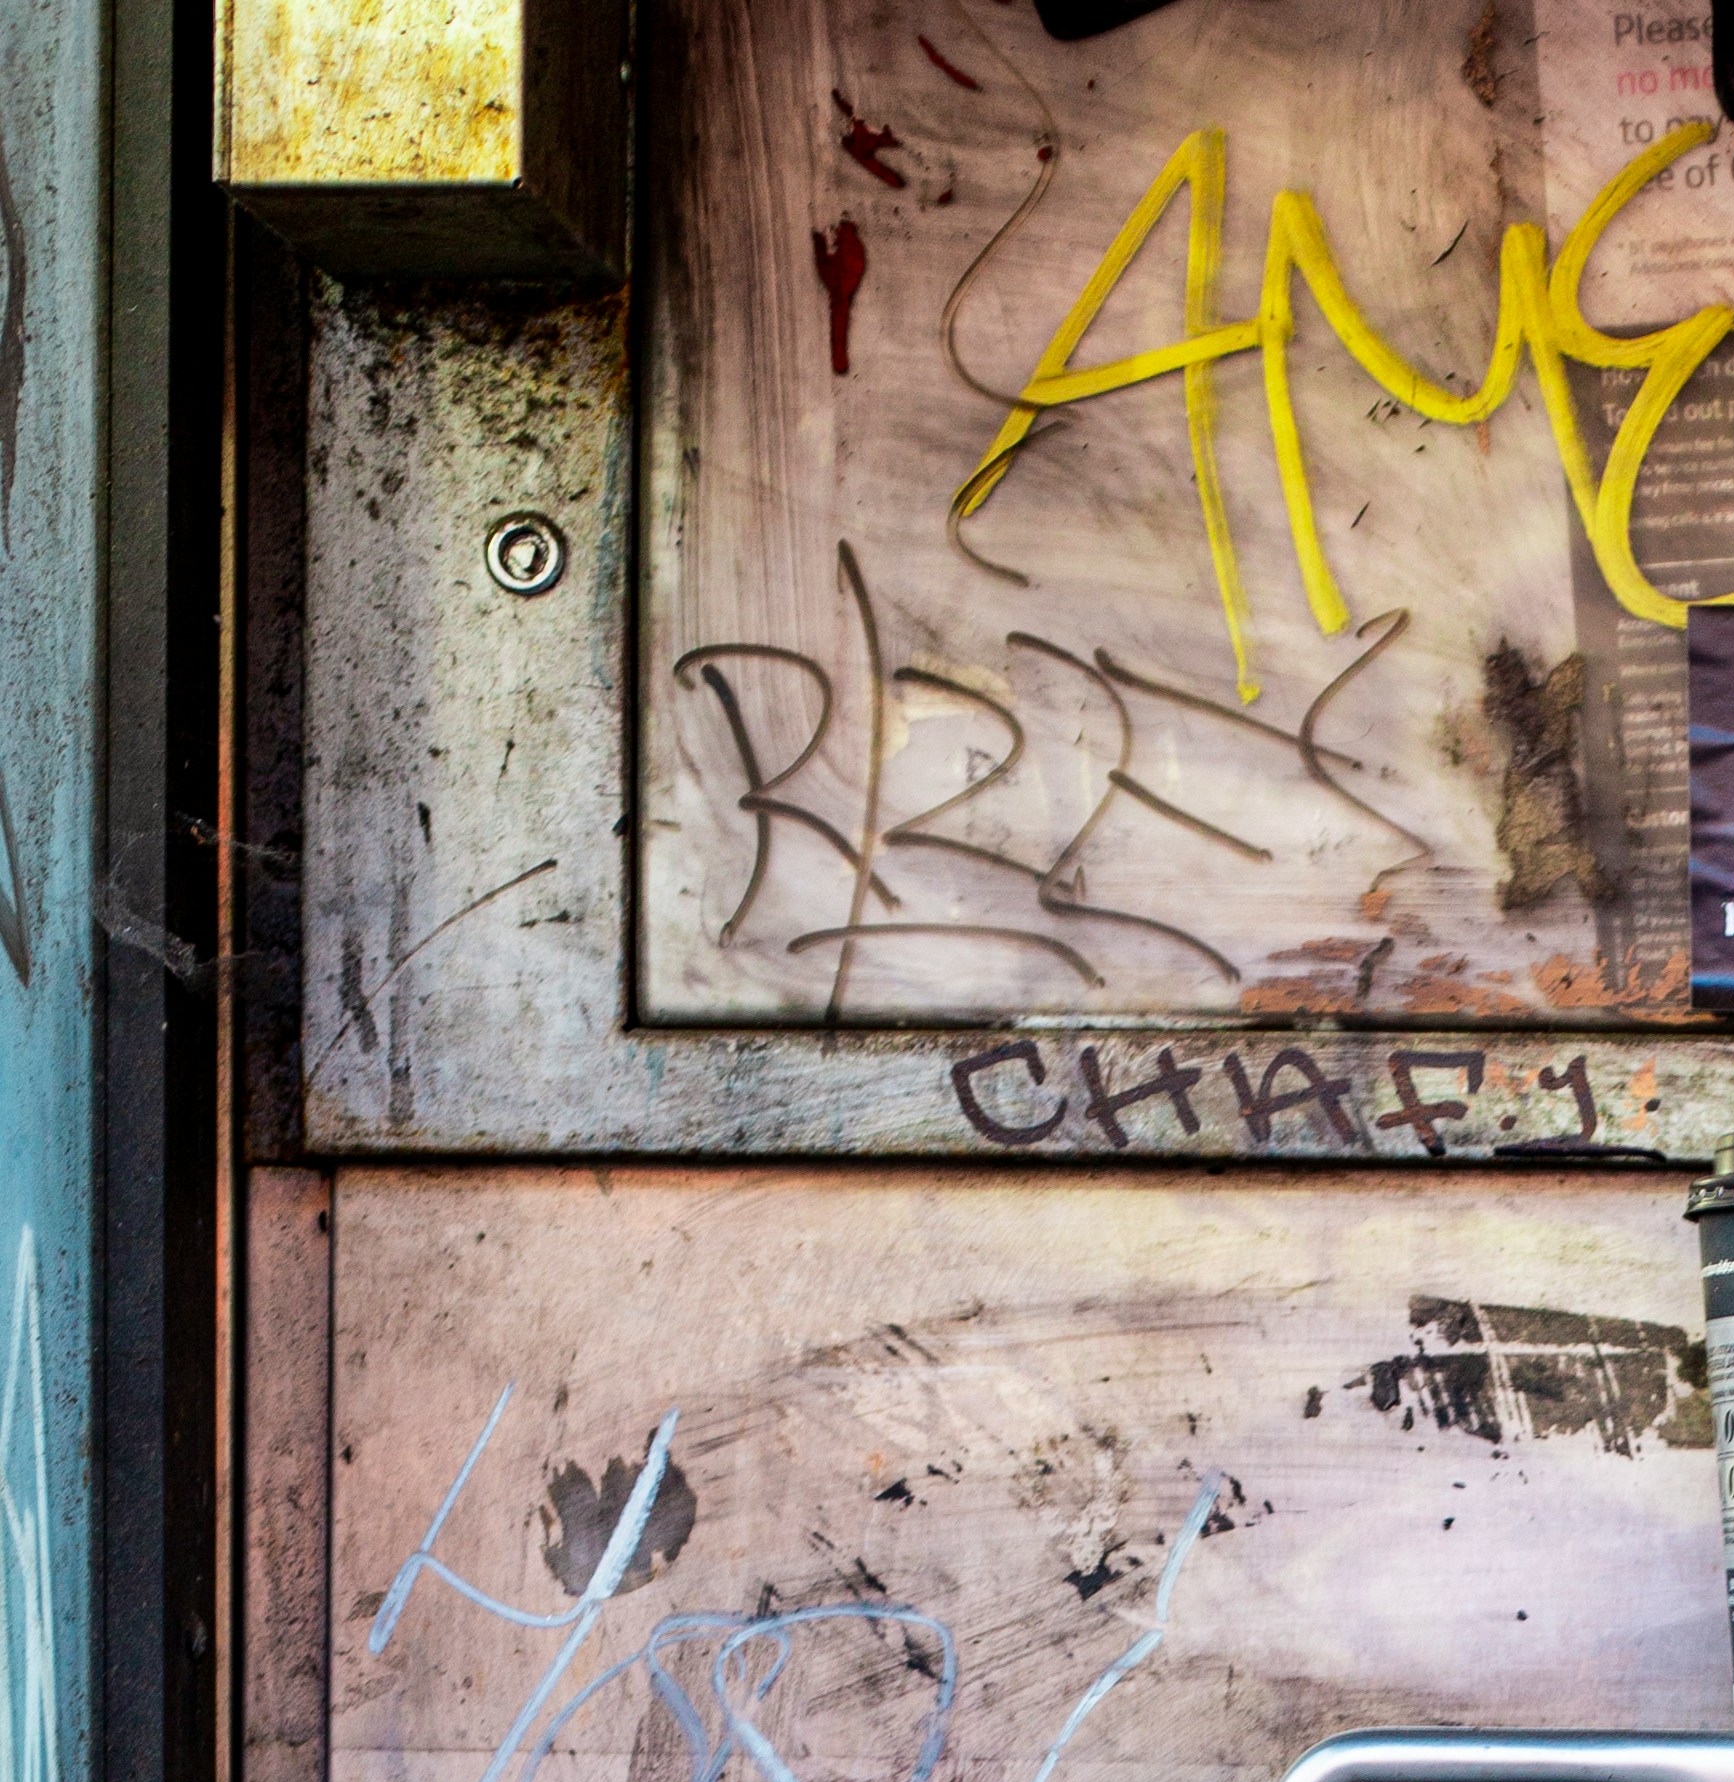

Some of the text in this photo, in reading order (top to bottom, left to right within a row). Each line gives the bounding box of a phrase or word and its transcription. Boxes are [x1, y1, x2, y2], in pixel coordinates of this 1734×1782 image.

[1616, 70, 1660, 96] no
[1619, 117, 1654, 146] to
[1685, 152, 1721, 188] of
[1683, 400, 1723, 422] out
